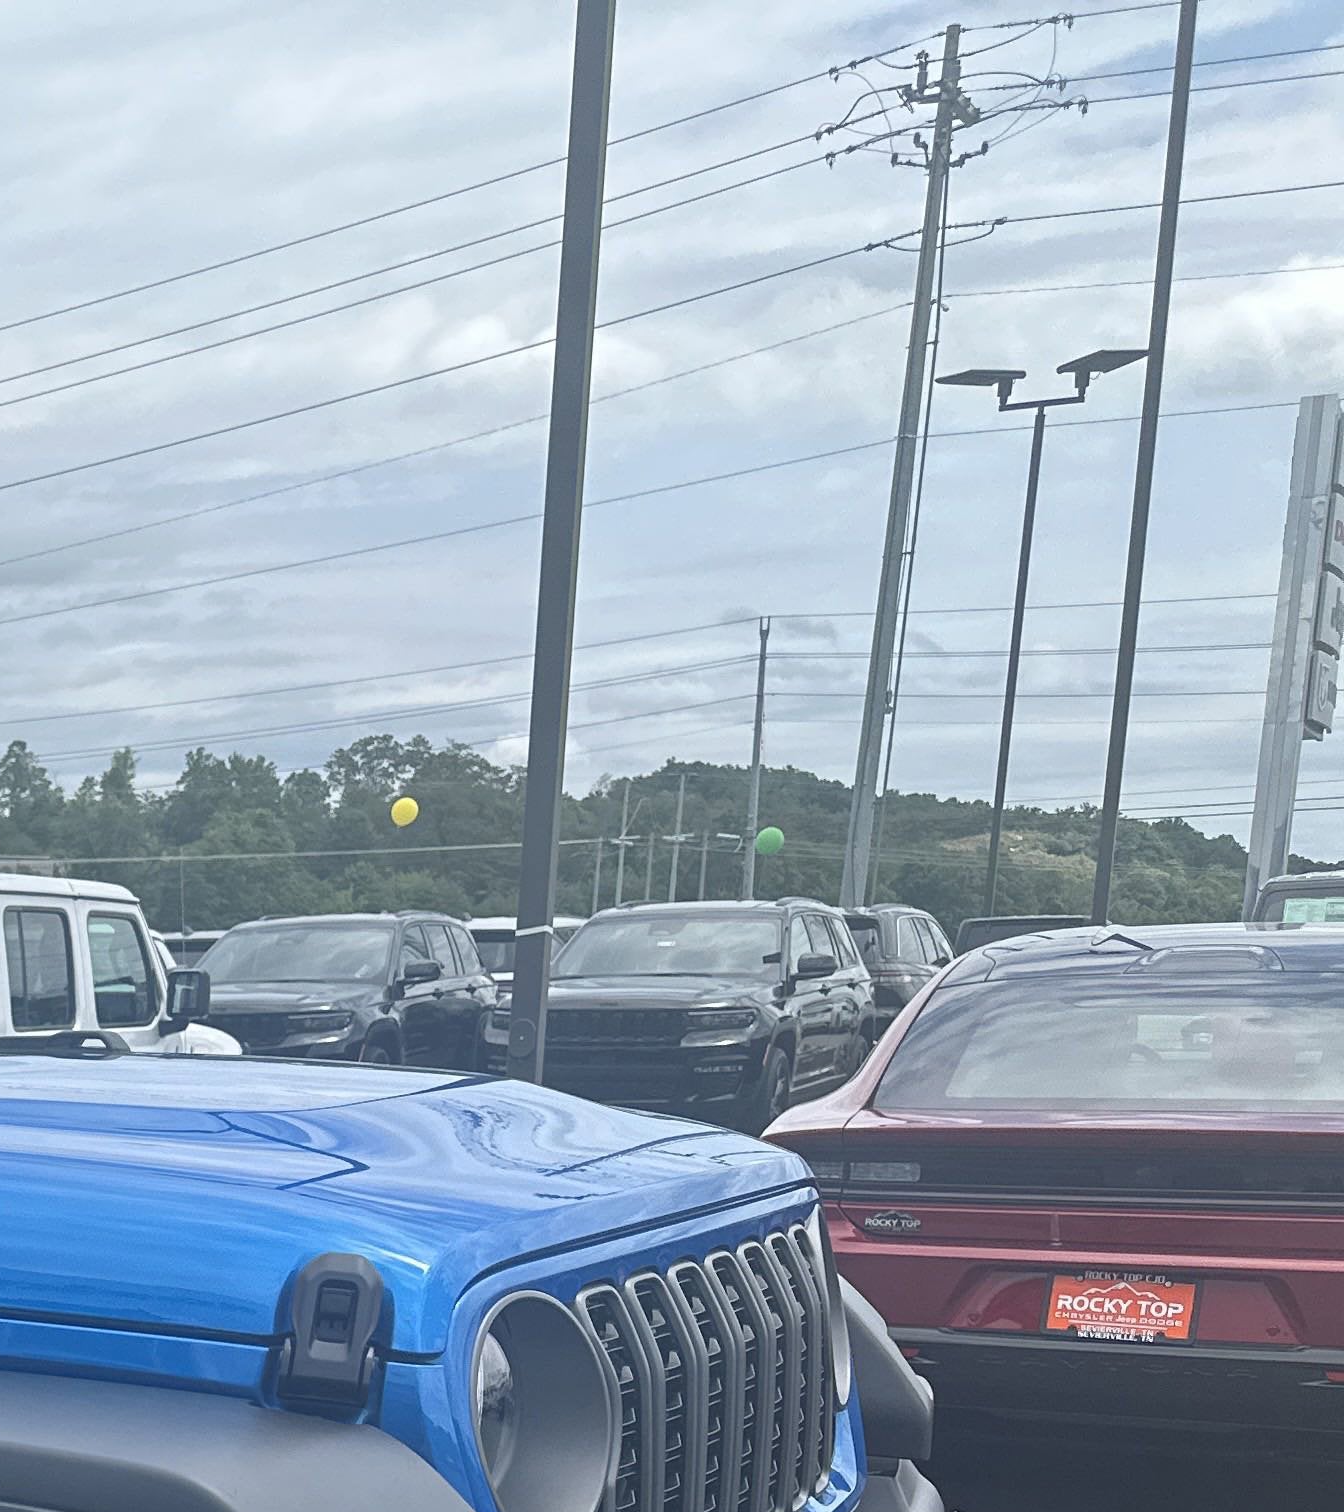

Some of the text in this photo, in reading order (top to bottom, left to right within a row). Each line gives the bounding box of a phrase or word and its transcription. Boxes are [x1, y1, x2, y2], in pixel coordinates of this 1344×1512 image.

[865, 1218, 921, 1228] ROCKY TOP
[1084, 1271, 1119, 1280] ROCKY
[1122, 1272, 1143, 1282] TOP
[1057, 1294, 1184, 1318] ROCKY TOP
[1054, 1311, 1183, 1327] CHRYSLER Jeep DODGE
